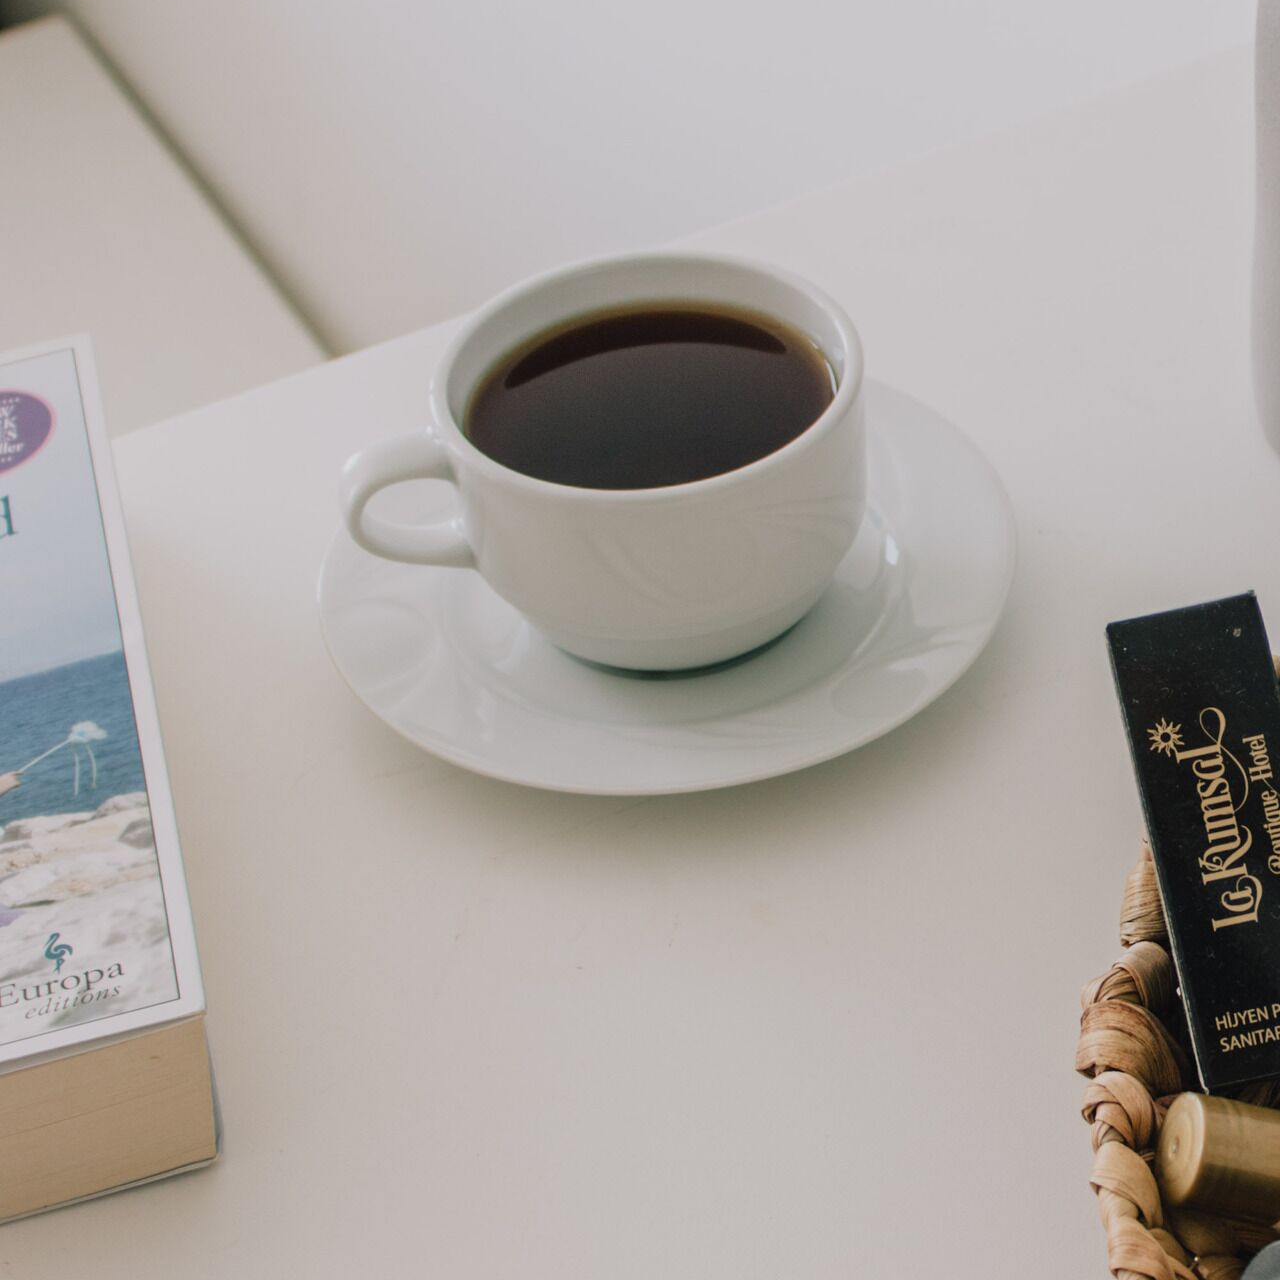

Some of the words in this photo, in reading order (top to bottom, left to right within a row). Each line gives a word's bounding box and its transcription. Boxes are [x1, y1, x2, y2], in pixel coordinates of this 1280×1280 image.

[1243, 733, 1274, 784] Hotel
[1177, 707, 1252, 886] Kumsal
[1212, 876, 1263, 932] La
[0, 962, 125, 1008] Europa
[25, 985, 122, 1020] editions
